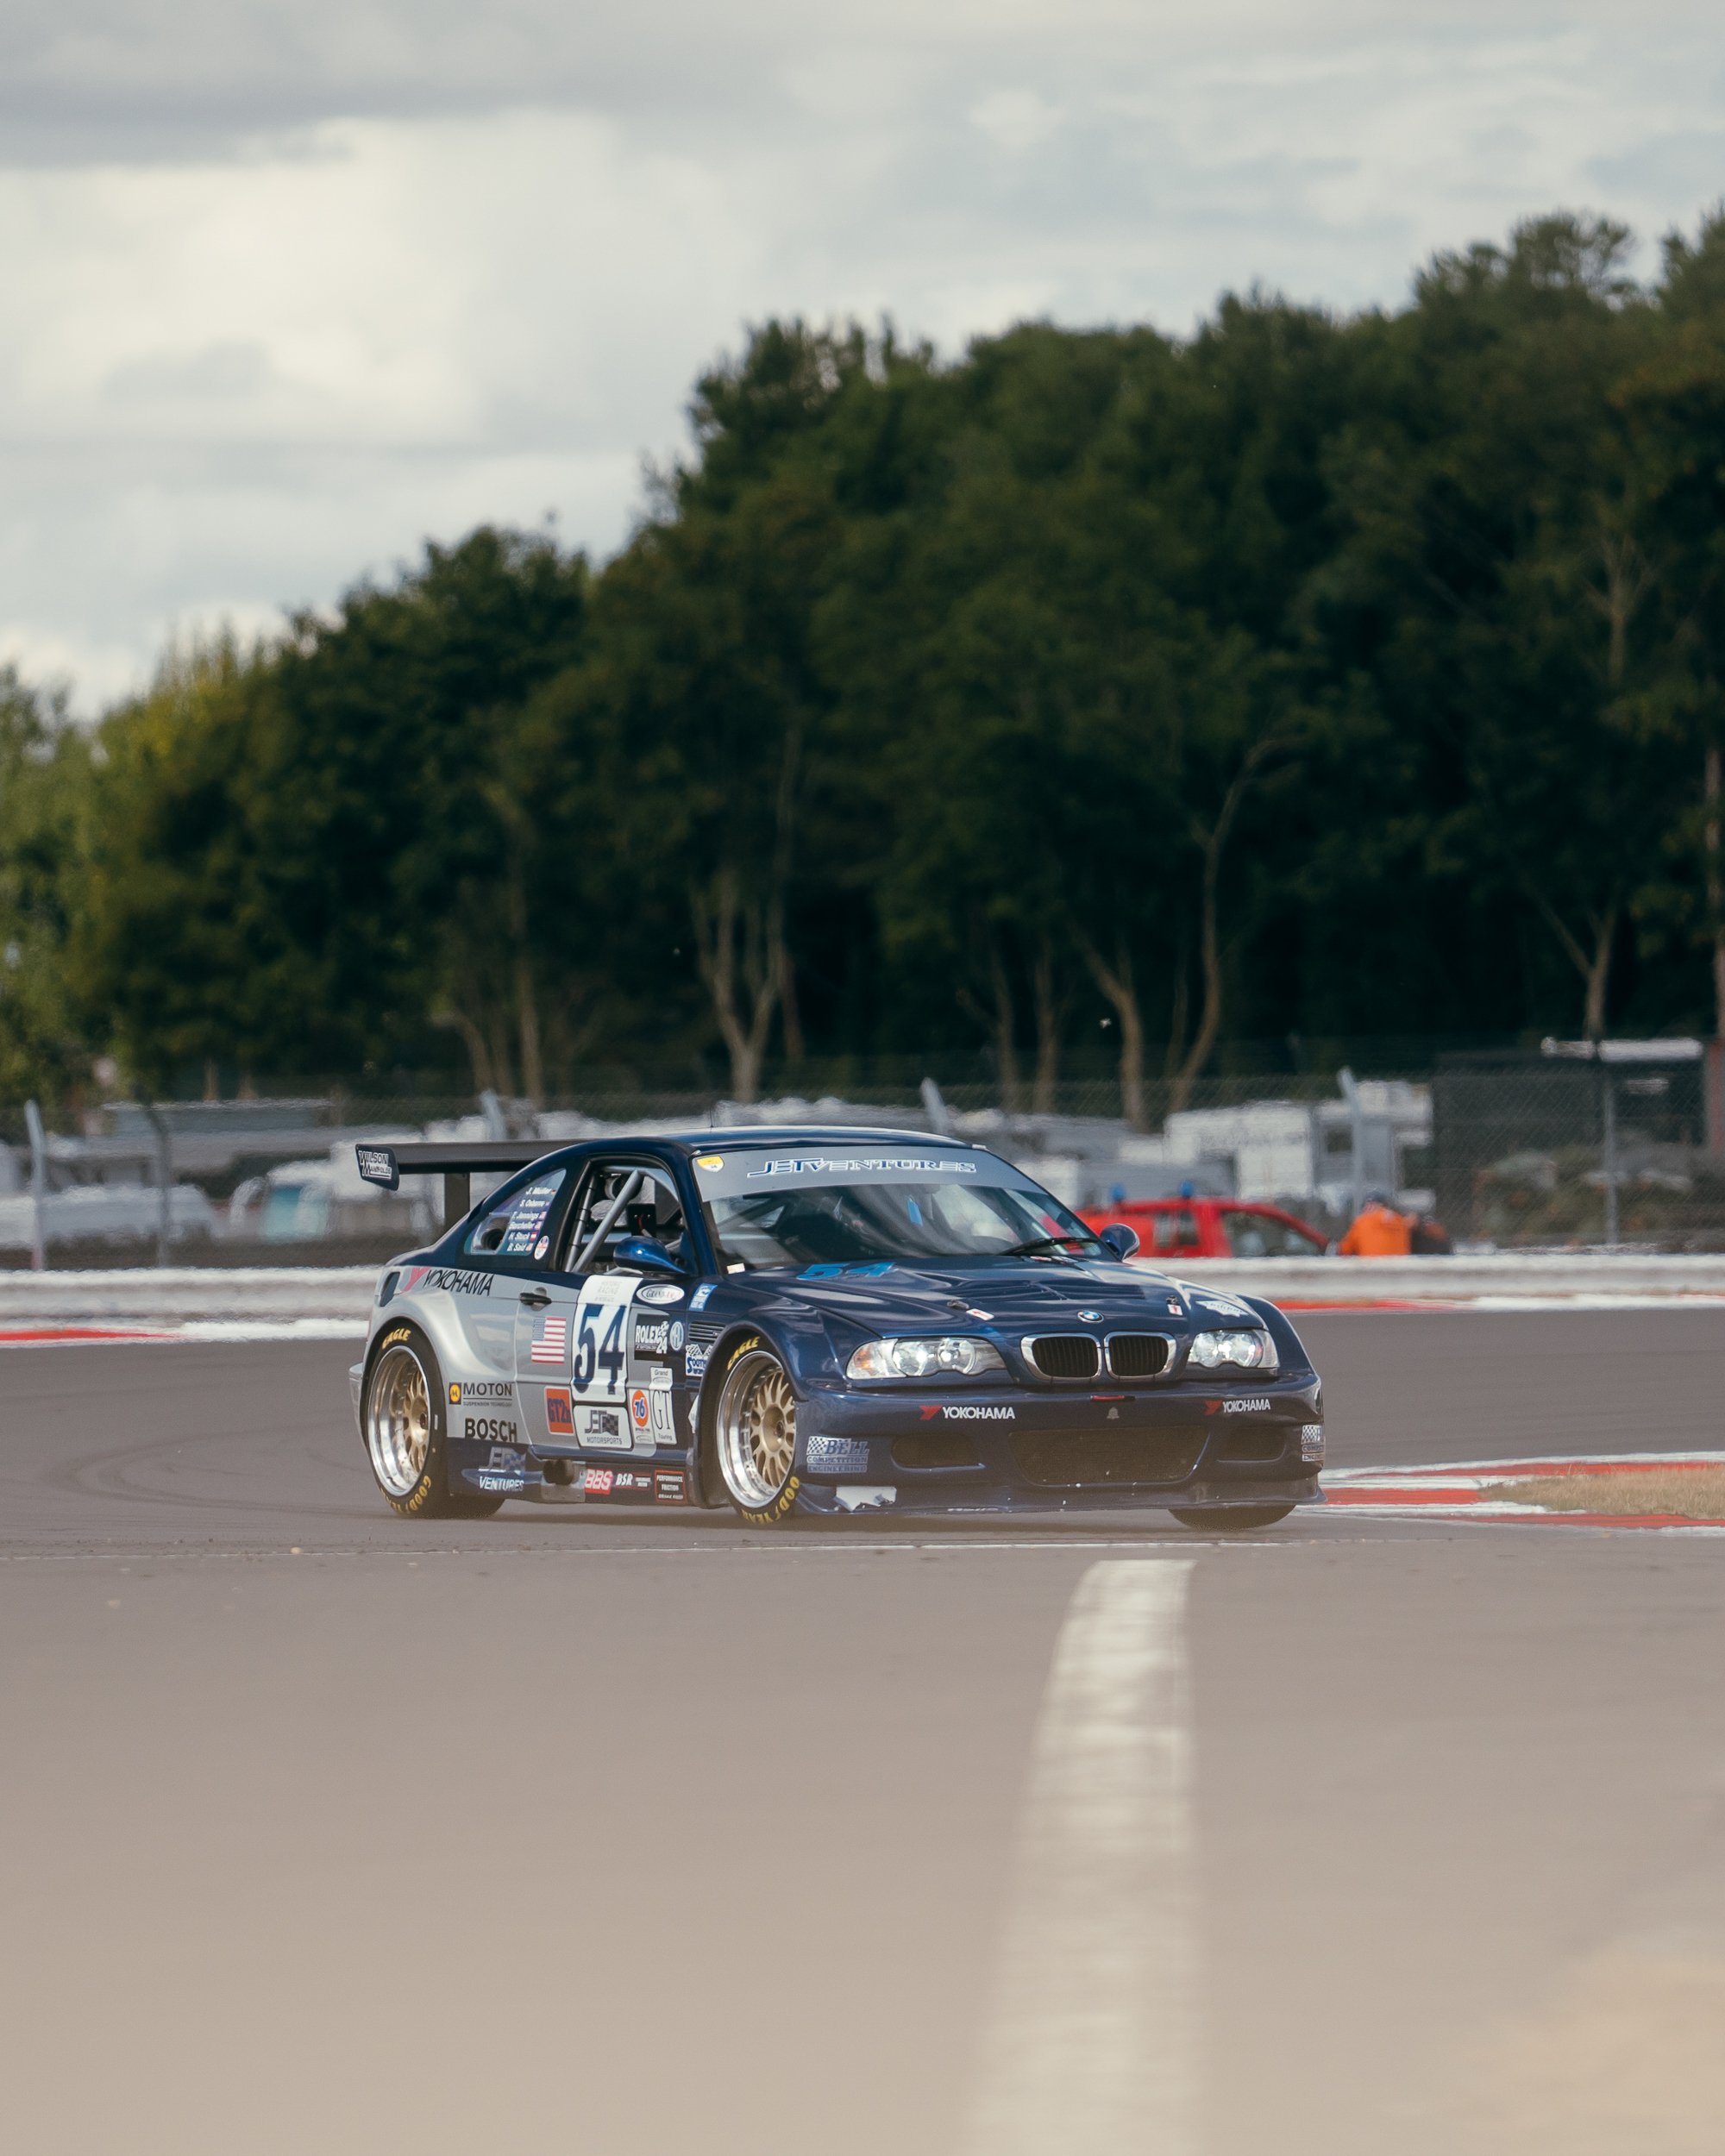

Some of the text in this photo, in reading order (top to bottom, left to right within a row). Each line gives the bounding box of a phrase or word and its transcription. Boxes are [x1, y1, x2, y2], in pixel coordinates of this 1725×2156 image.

[359, 1150, 389, 1165] WILSON
[796, 1261, 898, 1281] 54
[423, 1269, 495, 1296] YOKOHAMA
[381, 1329, 412, 1350] EAGLE
[574, 1302, 627, 1395] 54
[635, 1326, 660, 1344] ROLEX
[656, 1337, 668, 1354] 24
[726, 1337, 761, 1371] EAGLE
[463, 1382, 513, 1396] MOTON
[634, 1398, 645, 1418] 76
[652, 1390, 672, 1430] GT
[942, 1406, 1016, 1420] YOKOHAMA
[1222, 1398, 1271, 1413] YOKOHAMA
[464, 1417, 518, 1443] BOSCH
[658, 1432, 673, 1441] Touring
[586, 1436, 623, 1445] MOTORSPORTS
[825, 1439, 870, 1456] BELL
[807, 1456, 868, 1464] COMPETITION
[479, 1476, 525, 1492] VENTURES
[584, 1469, 612, 1491] BBS
[615, 1473, 634, 1487] BSR
